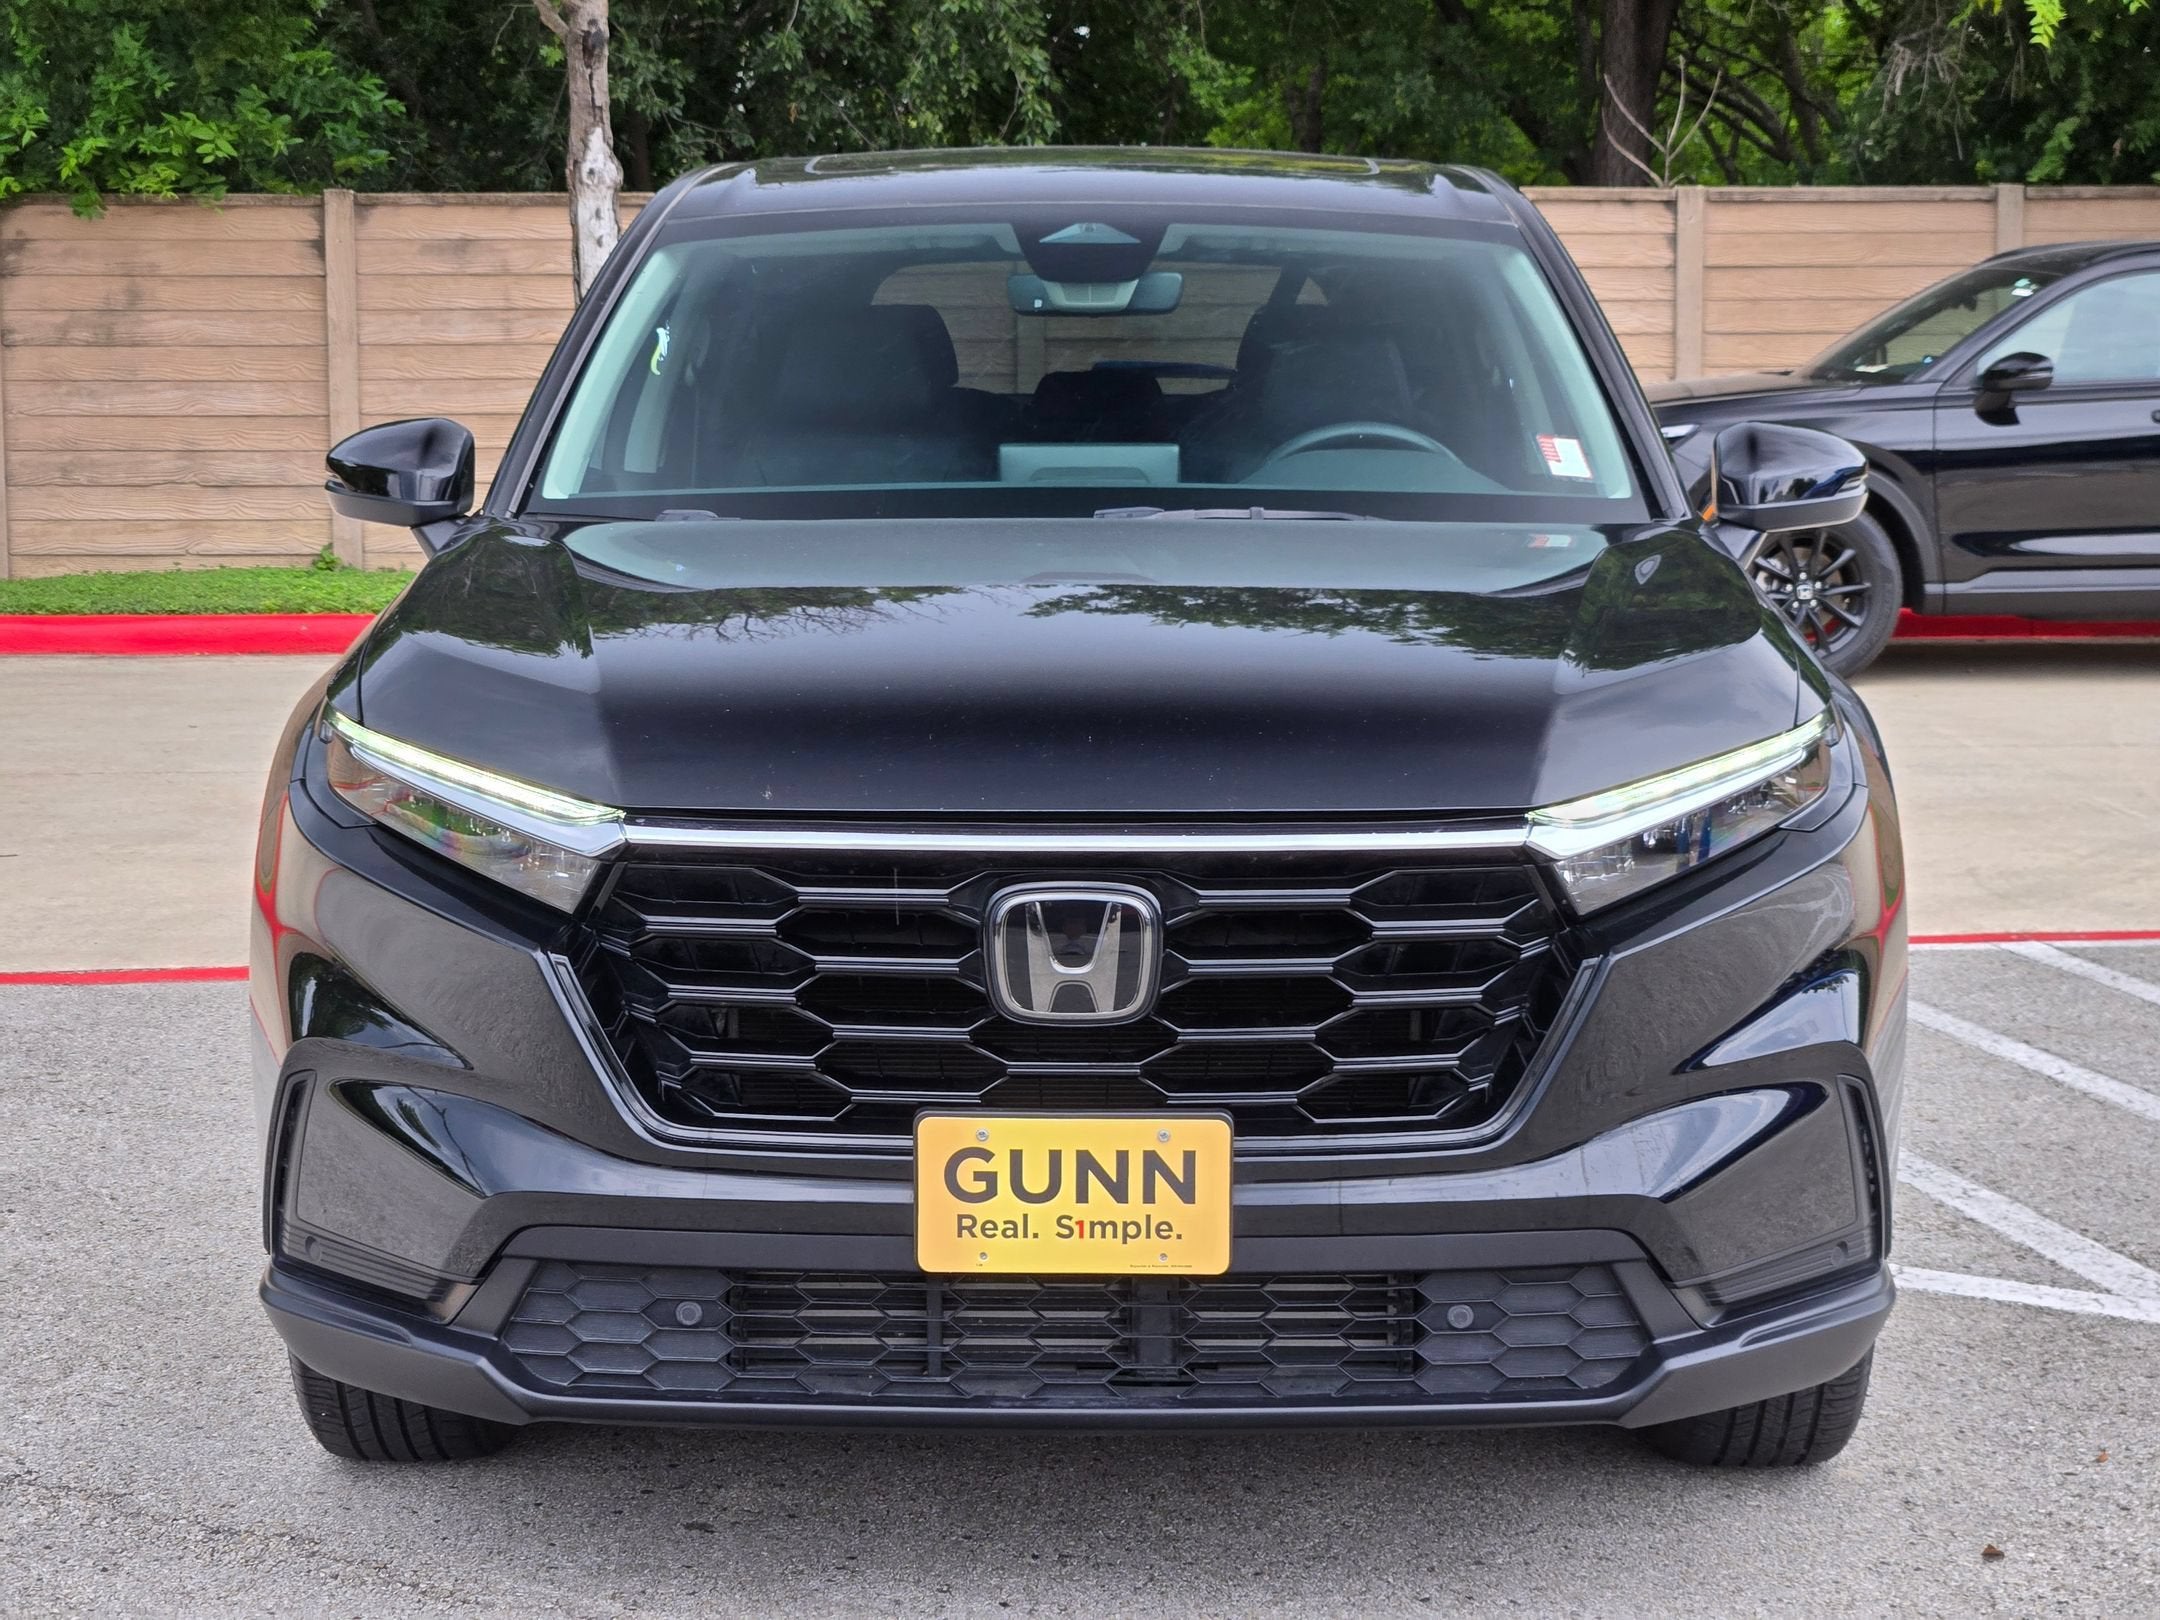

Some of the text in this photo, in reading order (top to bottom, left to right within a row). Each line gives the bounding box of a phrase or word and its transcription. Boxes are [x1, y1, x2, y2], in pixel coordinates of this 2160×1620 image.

[943, 1146, 1197, 1205] GUNN
[956, 1213, 1183, 1245] Real. S1mple.
